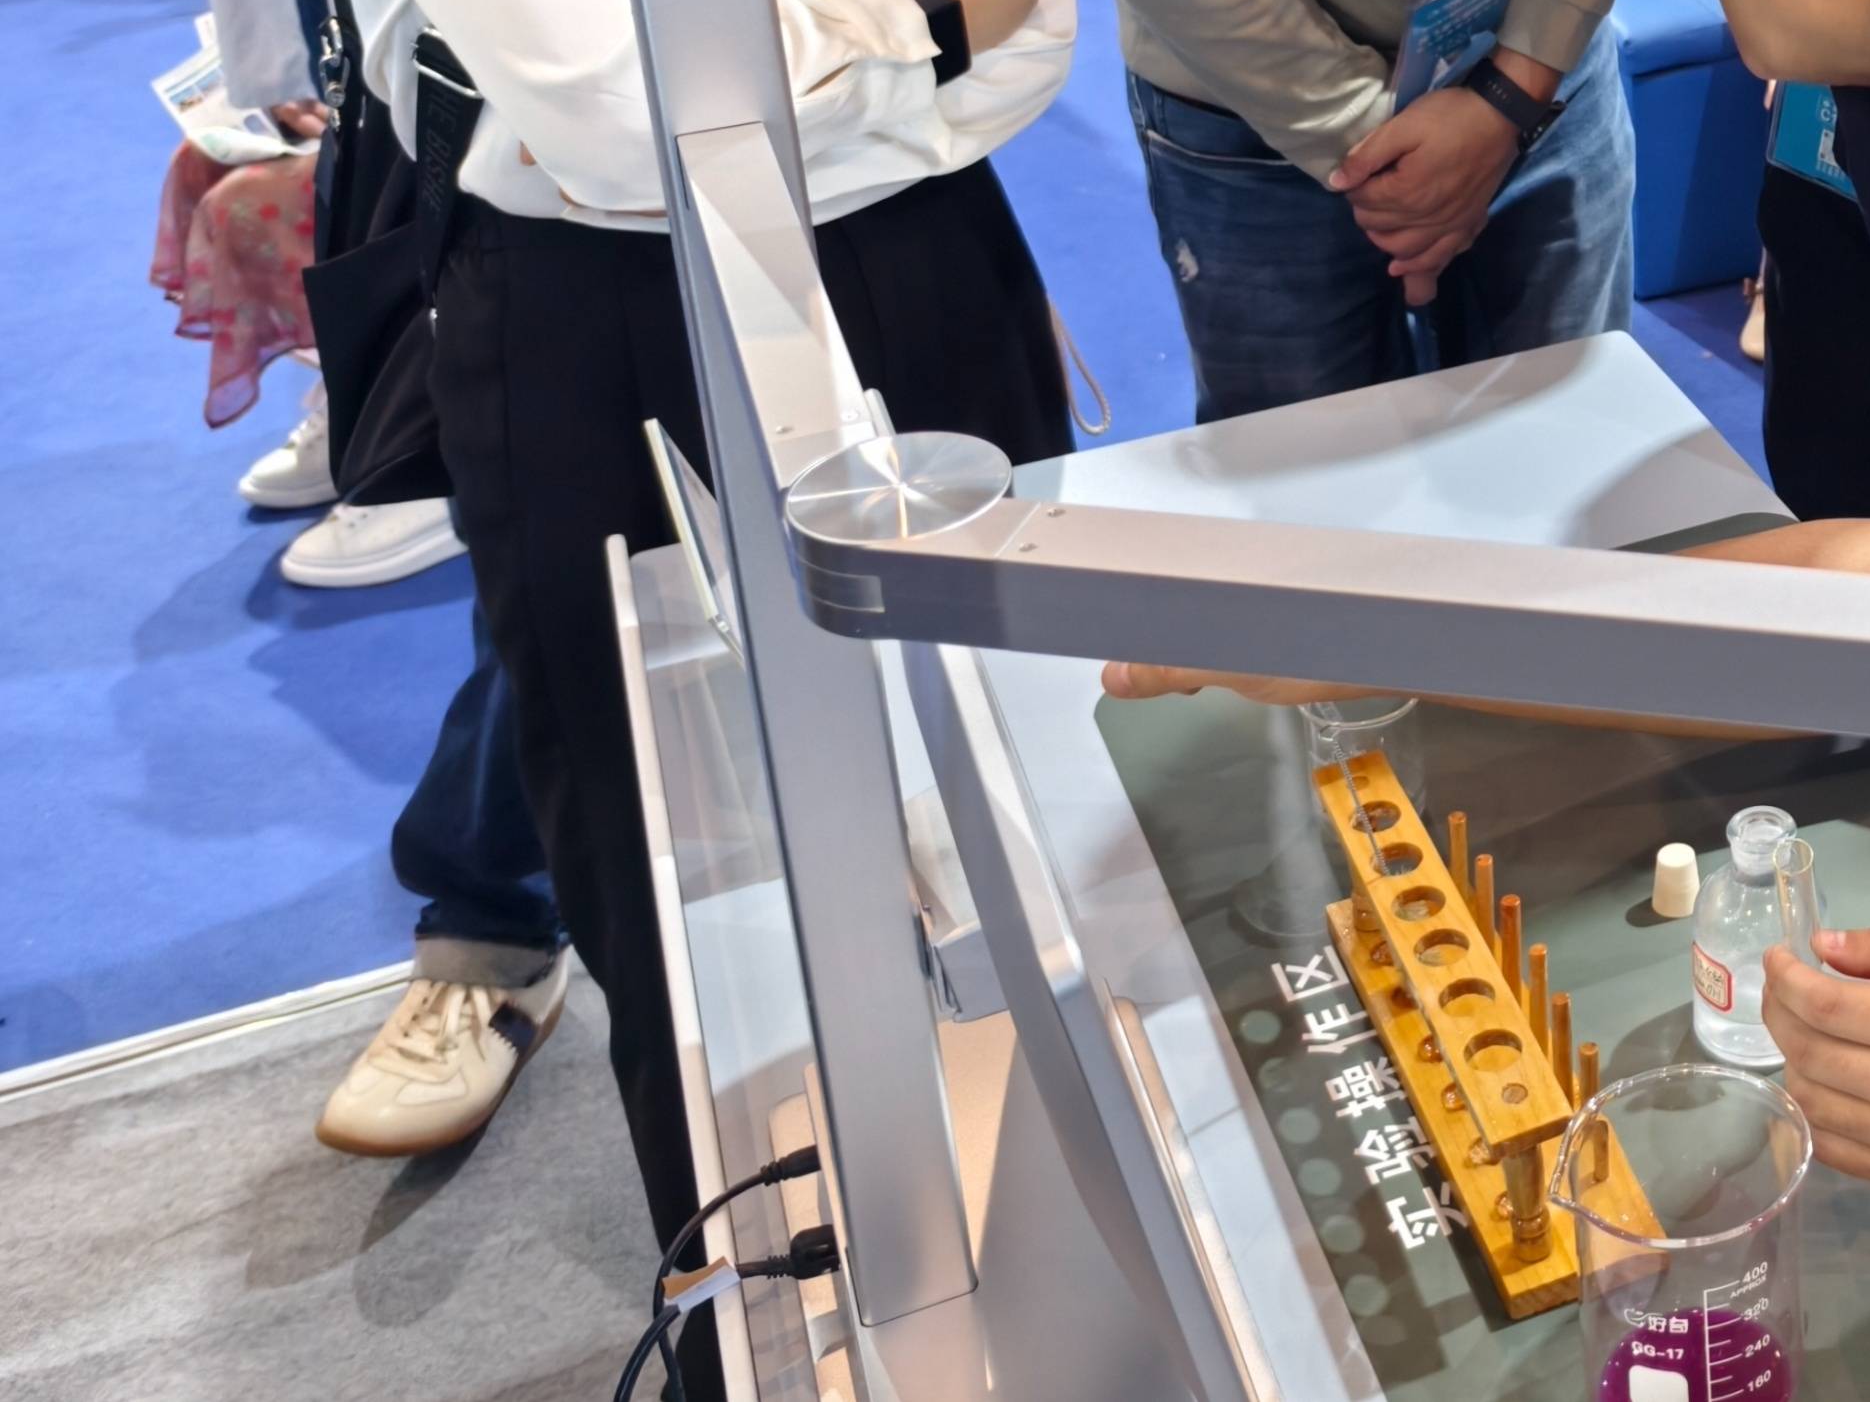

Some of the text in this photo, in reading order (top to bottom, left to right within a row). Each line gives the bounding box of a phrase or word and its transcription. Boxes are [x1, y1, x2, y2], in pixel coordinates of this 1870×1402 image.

[1272, 945, 1469, 1250] 实验操作区
[1742, 1261, 1768, 1284] 400
[1745, 1334, 1770, 1358] 240
[1747, 1369, 1771, 1392] 160
